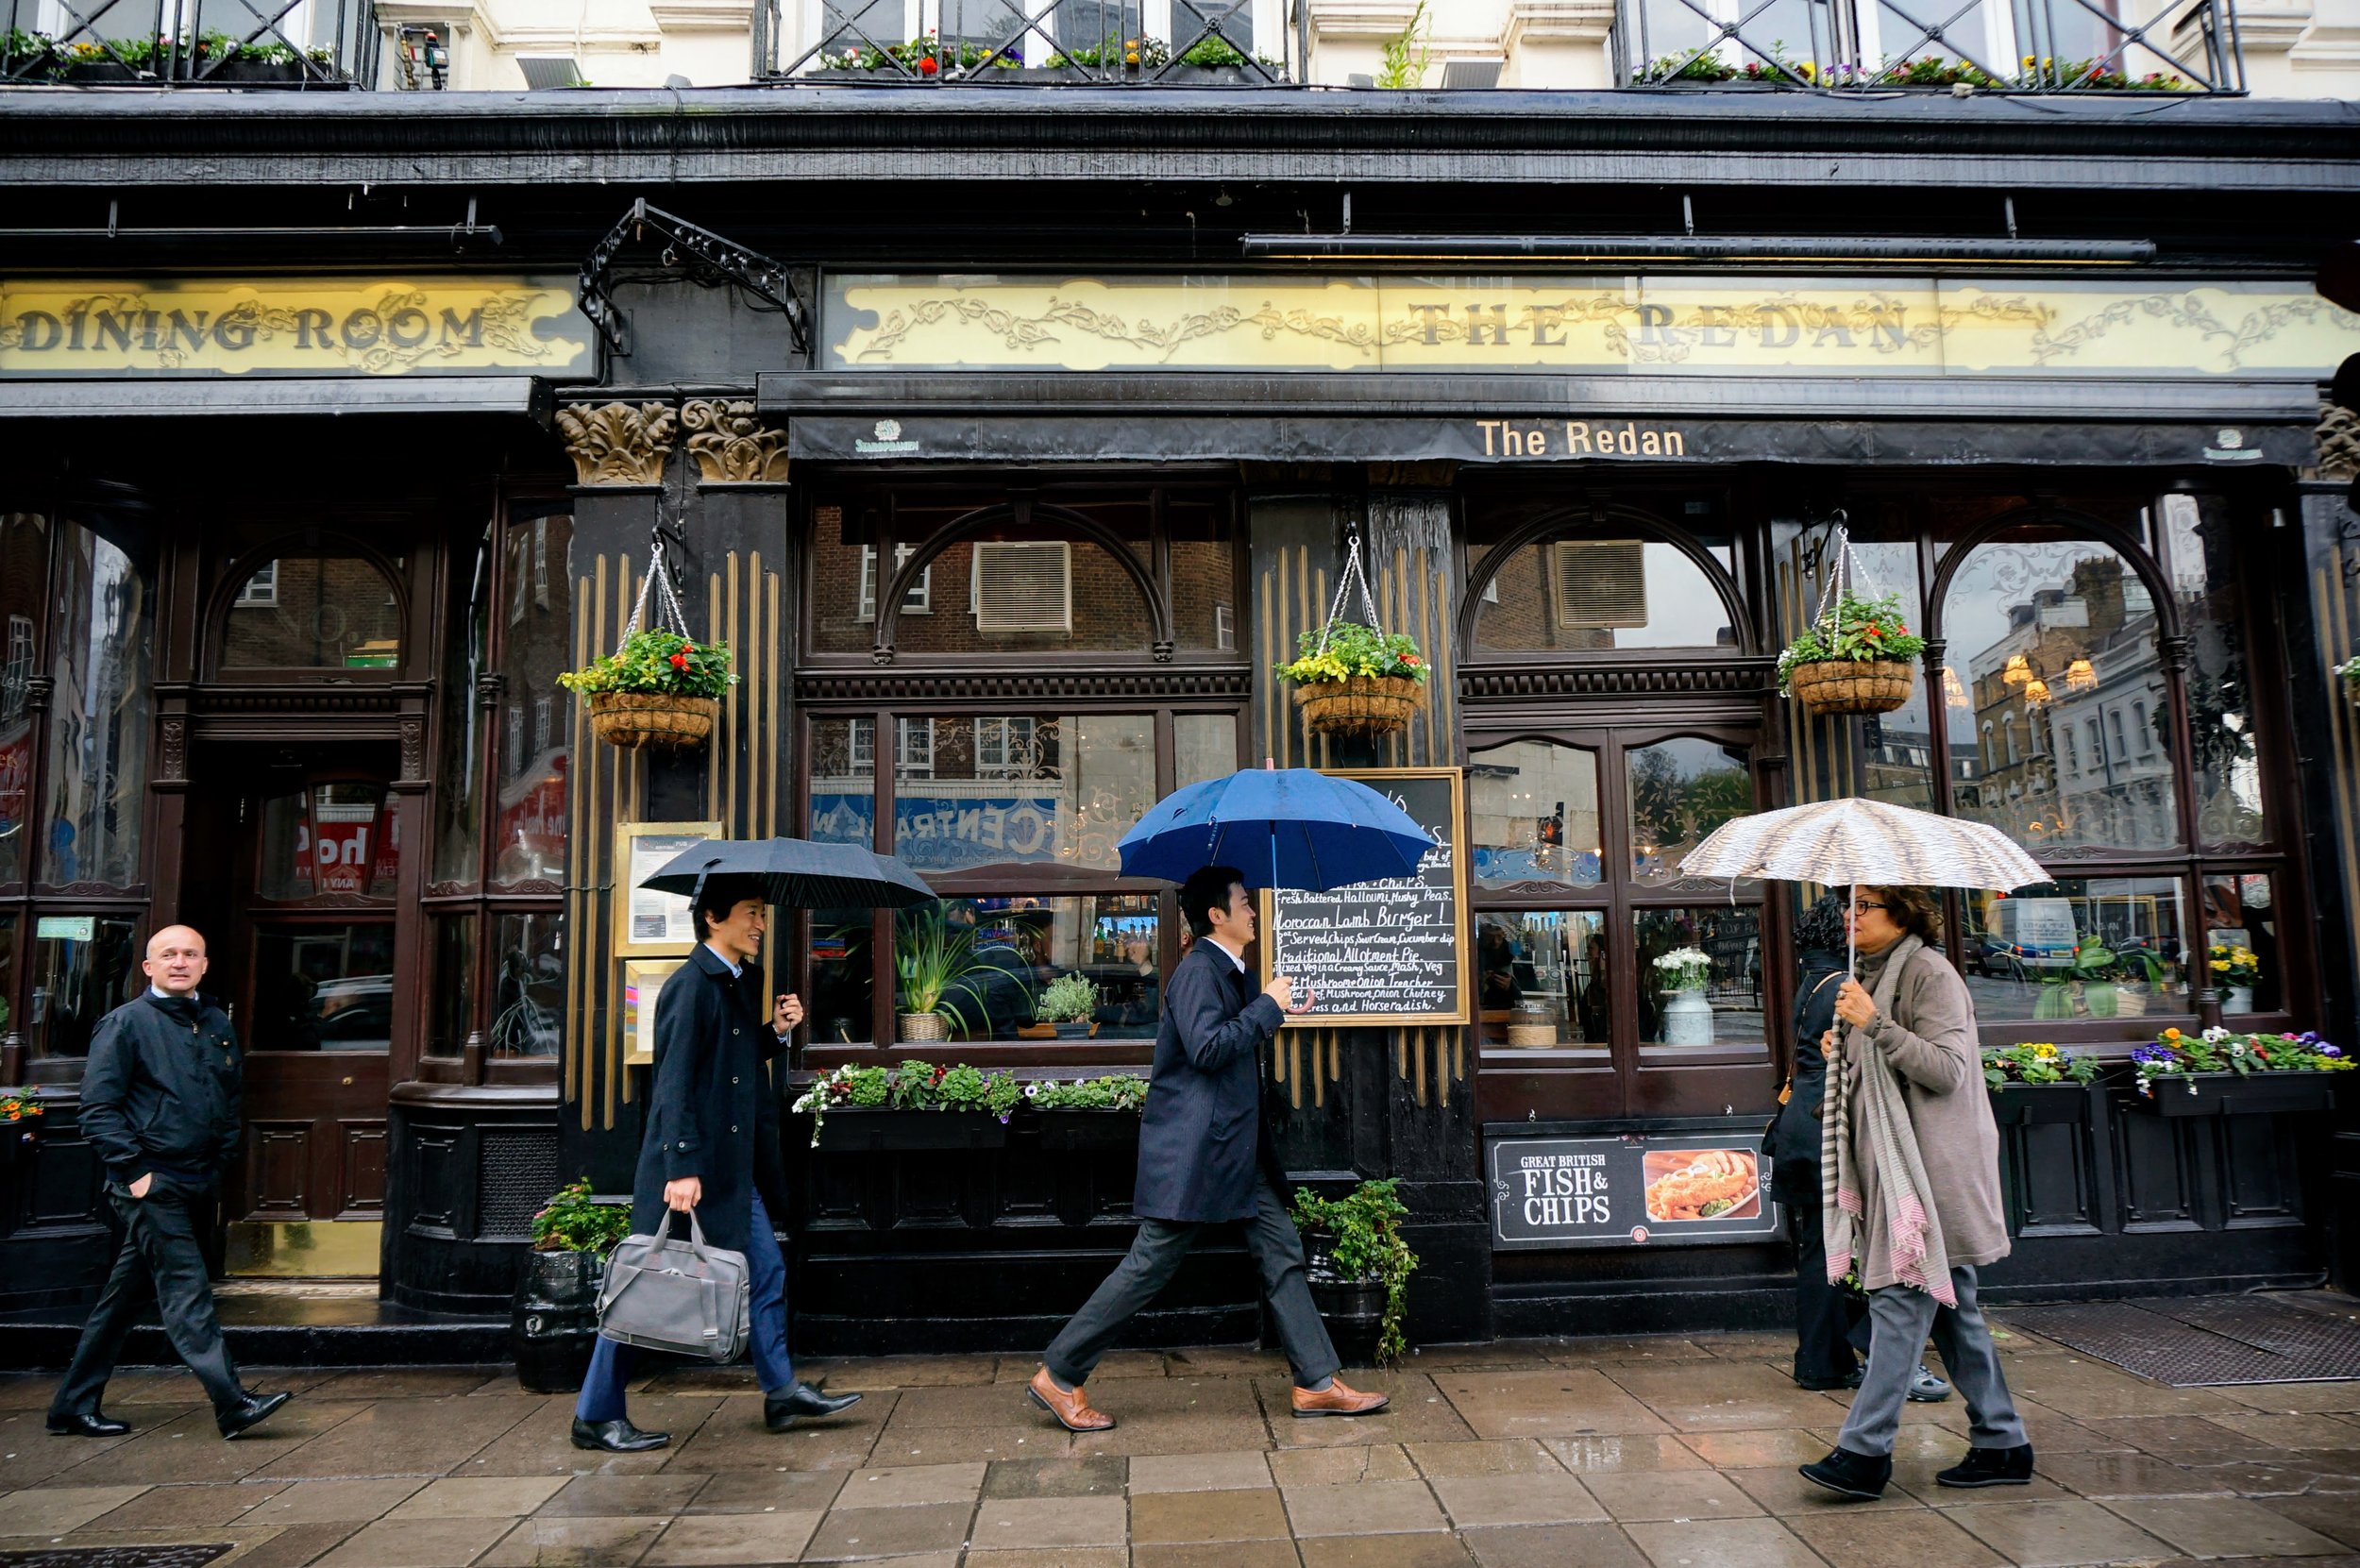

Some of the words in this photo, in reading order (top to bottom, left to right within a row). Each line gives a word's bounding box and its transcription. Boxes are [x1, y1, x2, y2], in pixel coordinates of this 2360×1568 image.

[17, 307, 257, 354] DINING
[295, 304, 486, 350] ROOM
[1408, 302, 1569, 346] THE
[1632, 302, 1915, 353] REDAN
[1475, 421, 1545, 456] The
[1566, 421, 1684, 456] Redan
[1441, 850, 1452, 862] of
[1303, 891, 1342, 903] Battered
[1335, 904, 1370, 928] Lamb
[1439, 933, 1455, 947] dip
[1274, 944, 1342, 963] Traditional
[1343, 947, 1399, 963] Allotment
[1334, 963, 1364, 977] Creamy
[1424, 962, 1443, 976] Veg
[1388, 971, 1434, 987] Trencher
[1403, 987, 1446, 1003] Chutney
[1332, 1000, 1358, 1012] and
[1520, 1155, 1556, 1168] GREAT
[1559, 1154, 1606, 1167] BRITISH
[1524, 1196, 1610, 1226] CHIPS
